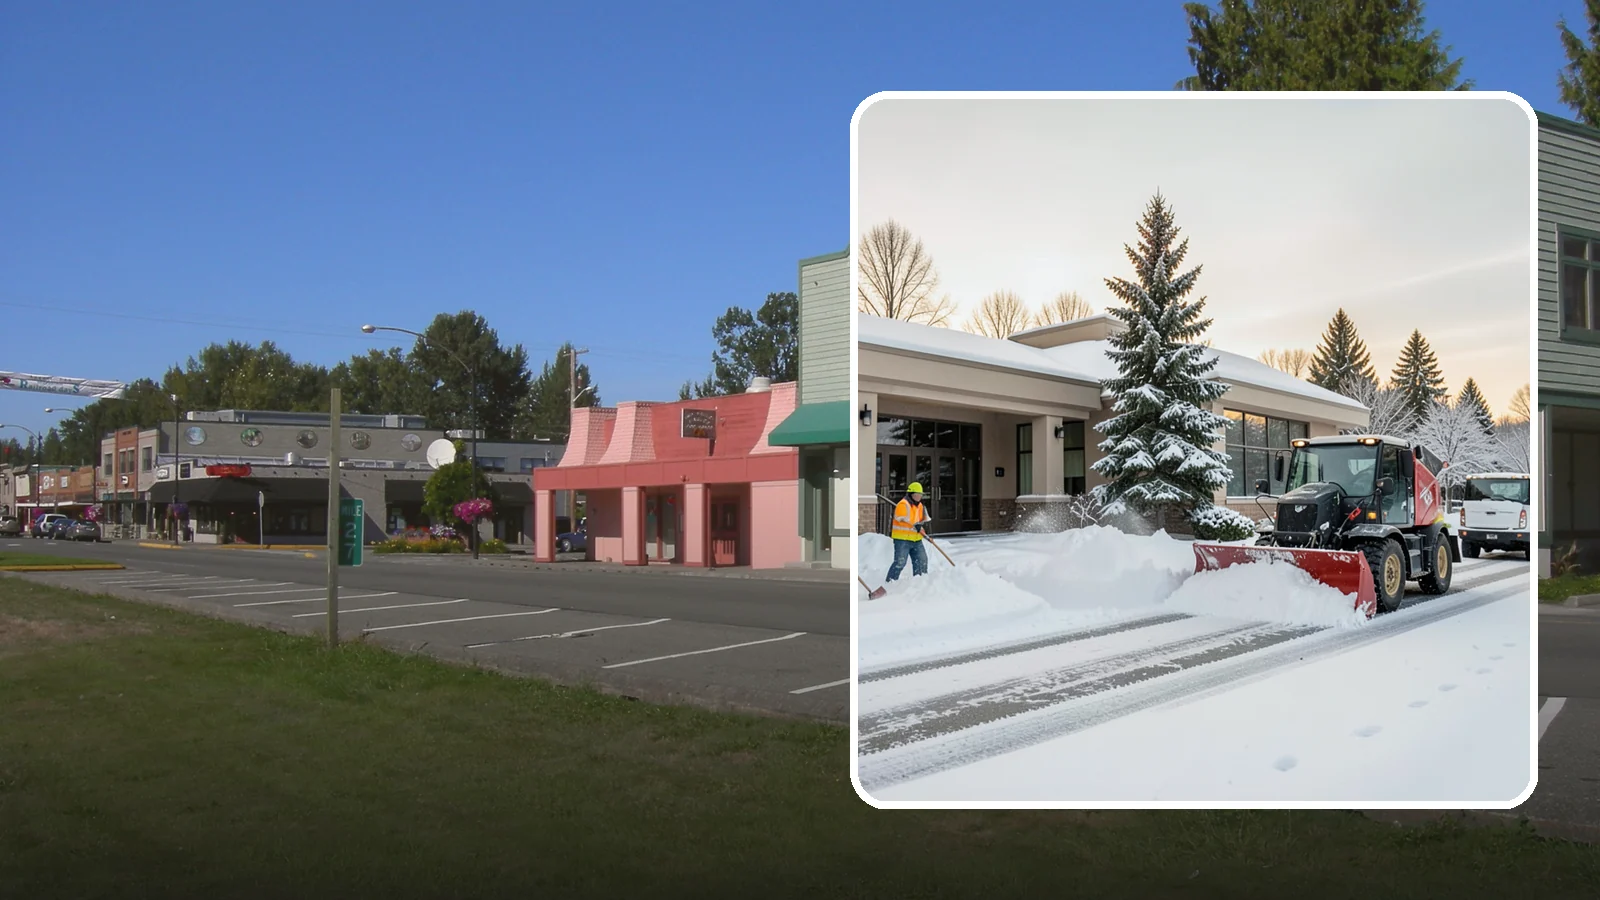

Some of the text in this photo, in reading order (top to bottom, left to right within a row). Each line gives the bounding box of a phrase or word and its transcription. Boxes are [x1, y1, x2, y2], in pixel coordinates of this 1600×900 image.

[341, 505, 362, 517] MILE
[345, 522, 356, 538] 2
[344, 543, 356, 559] 7
